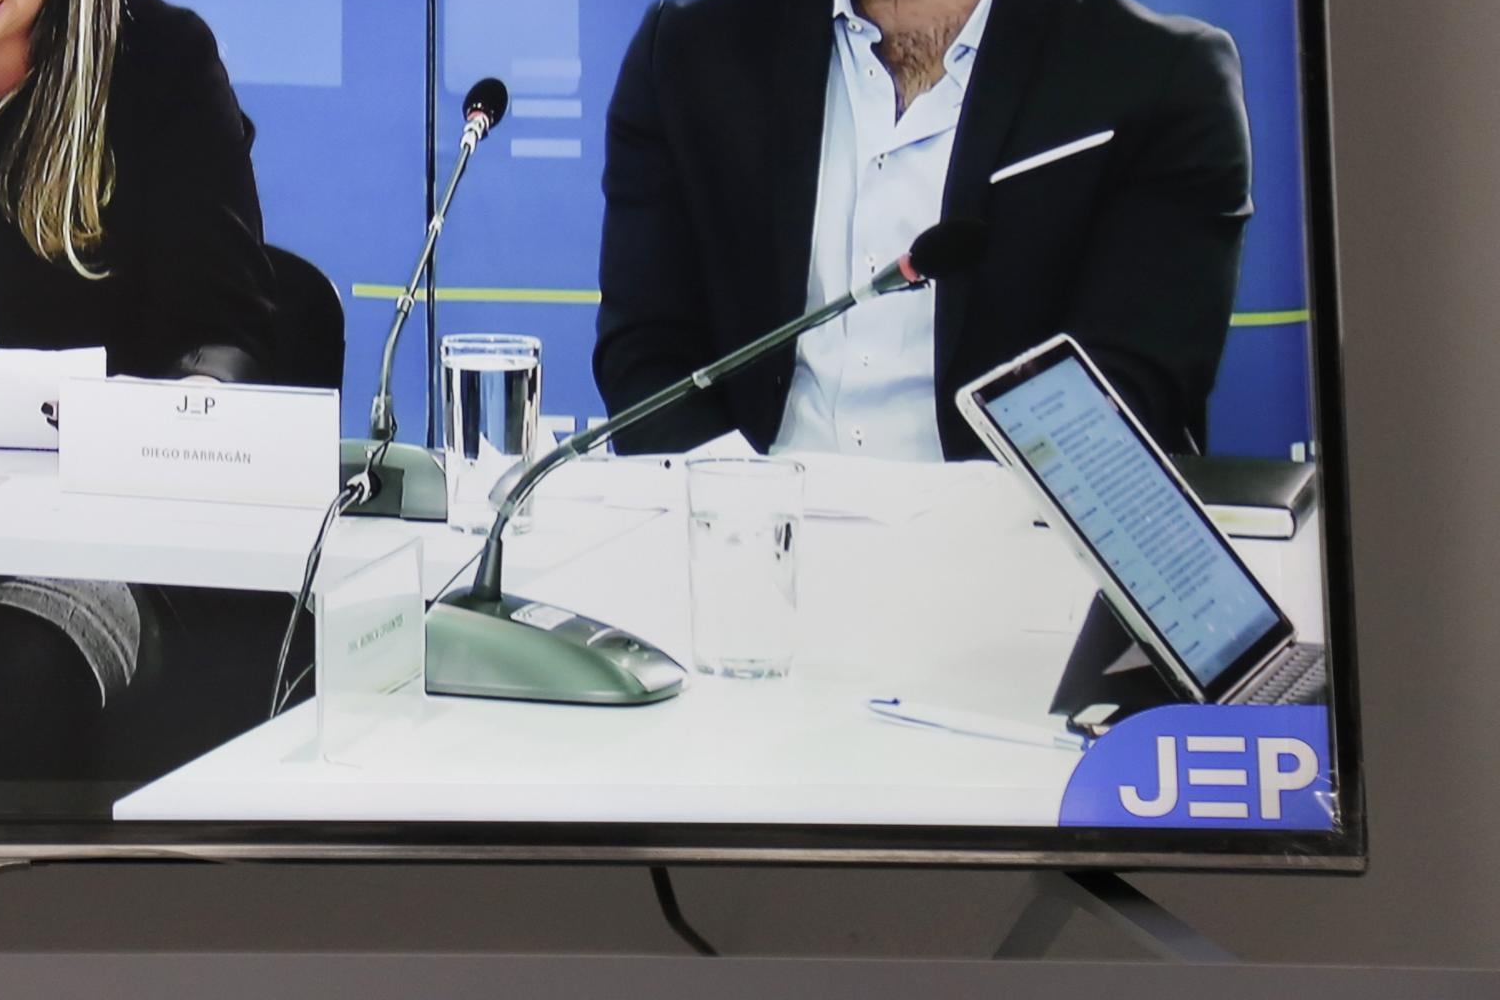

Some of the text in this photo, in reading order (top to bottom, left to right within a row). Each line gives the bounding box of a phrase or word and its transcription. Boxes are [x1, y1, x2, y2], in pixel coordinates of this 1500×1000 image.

[141, 446, 252, 465] DIEGO BARRAGÁN
[1119, 736, 1319, 820] JEP
